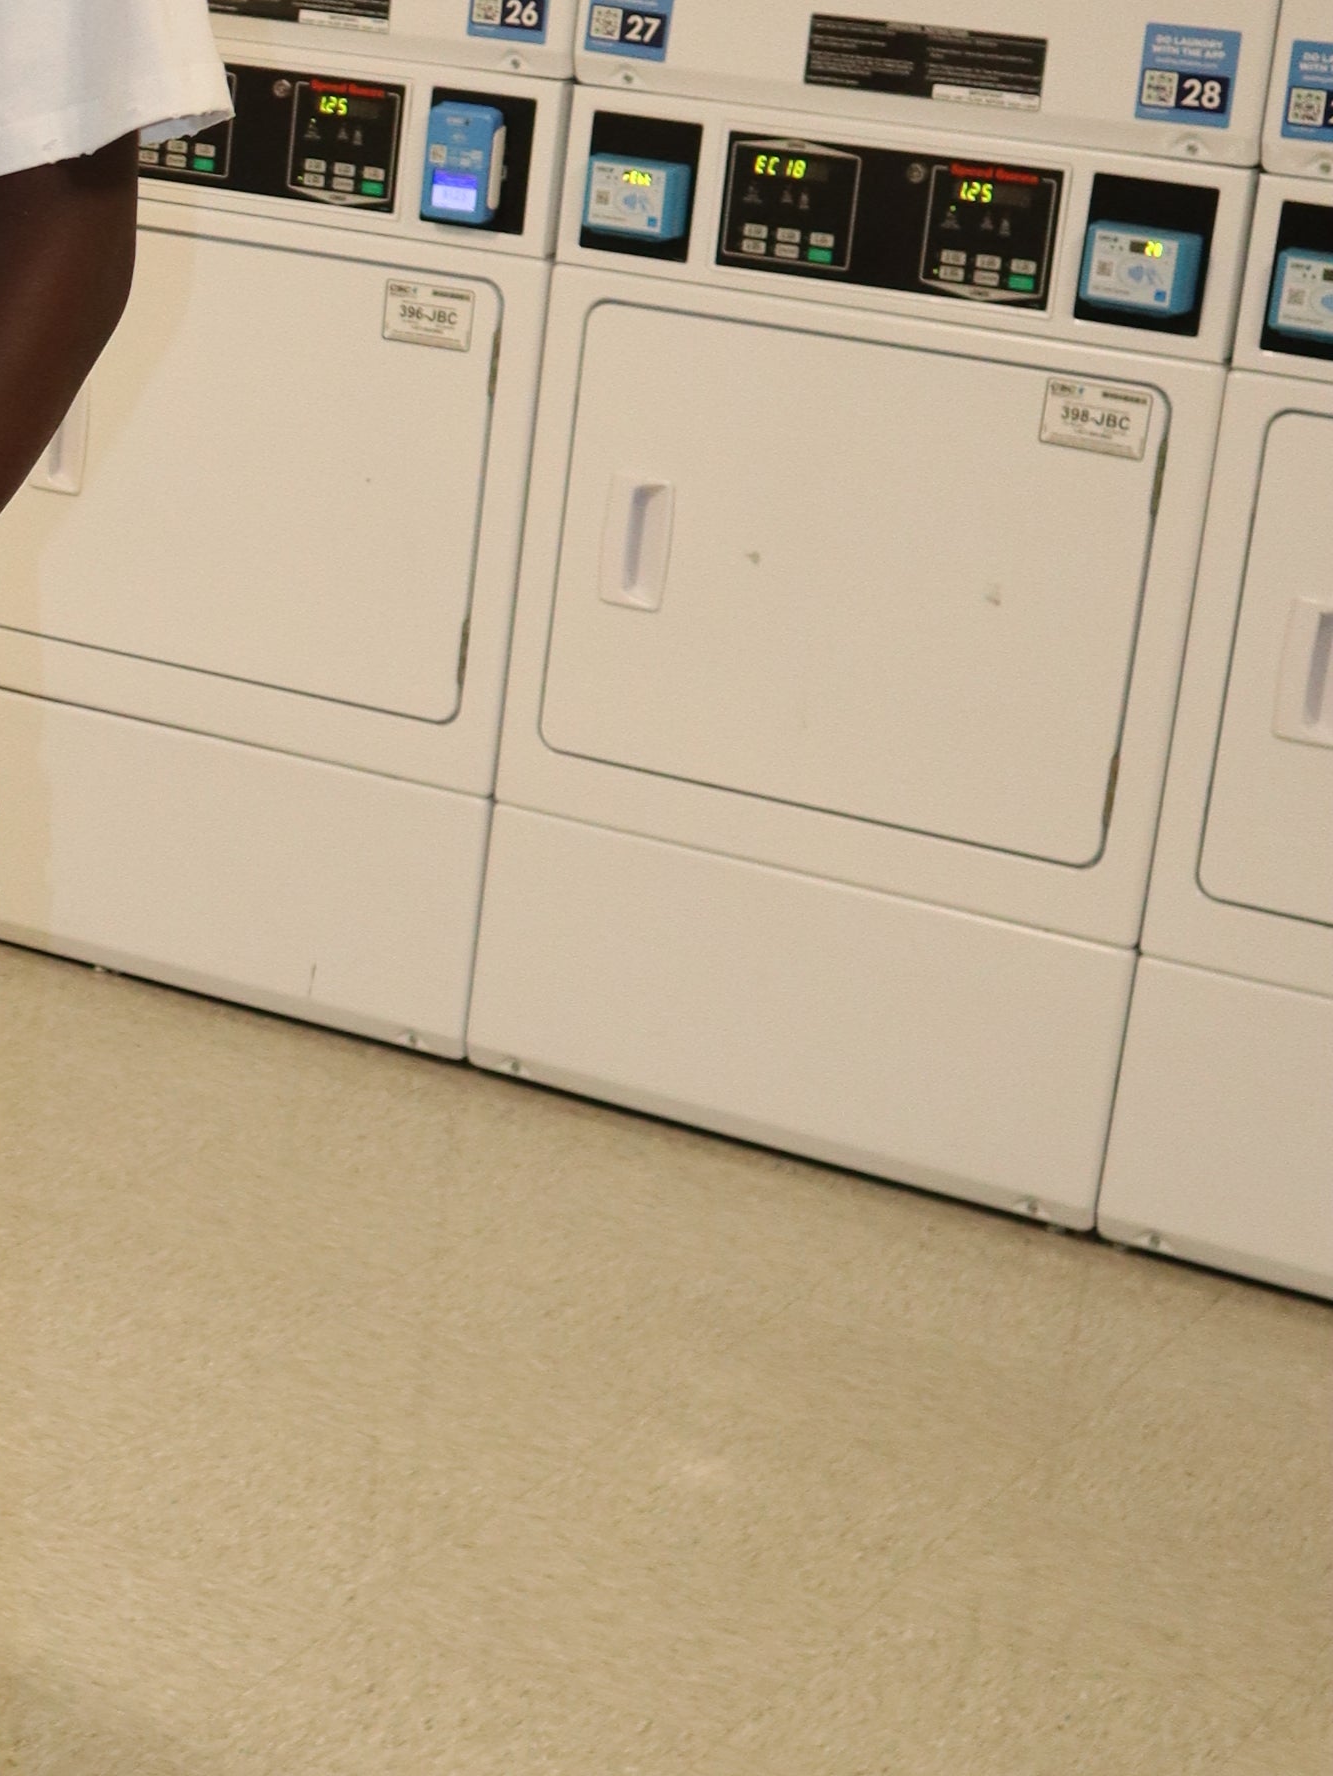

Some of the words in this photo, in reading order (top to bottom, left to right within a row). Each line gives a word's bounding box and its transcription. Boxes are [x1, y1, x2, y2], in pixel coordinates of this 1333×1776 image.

[625, 14, 662, 43] 27
[1180, 78, 1222, 110] 28
[399, 304, 459, 326] 396-JBC
[1060, 405, 1131, 431] 398-JBC
